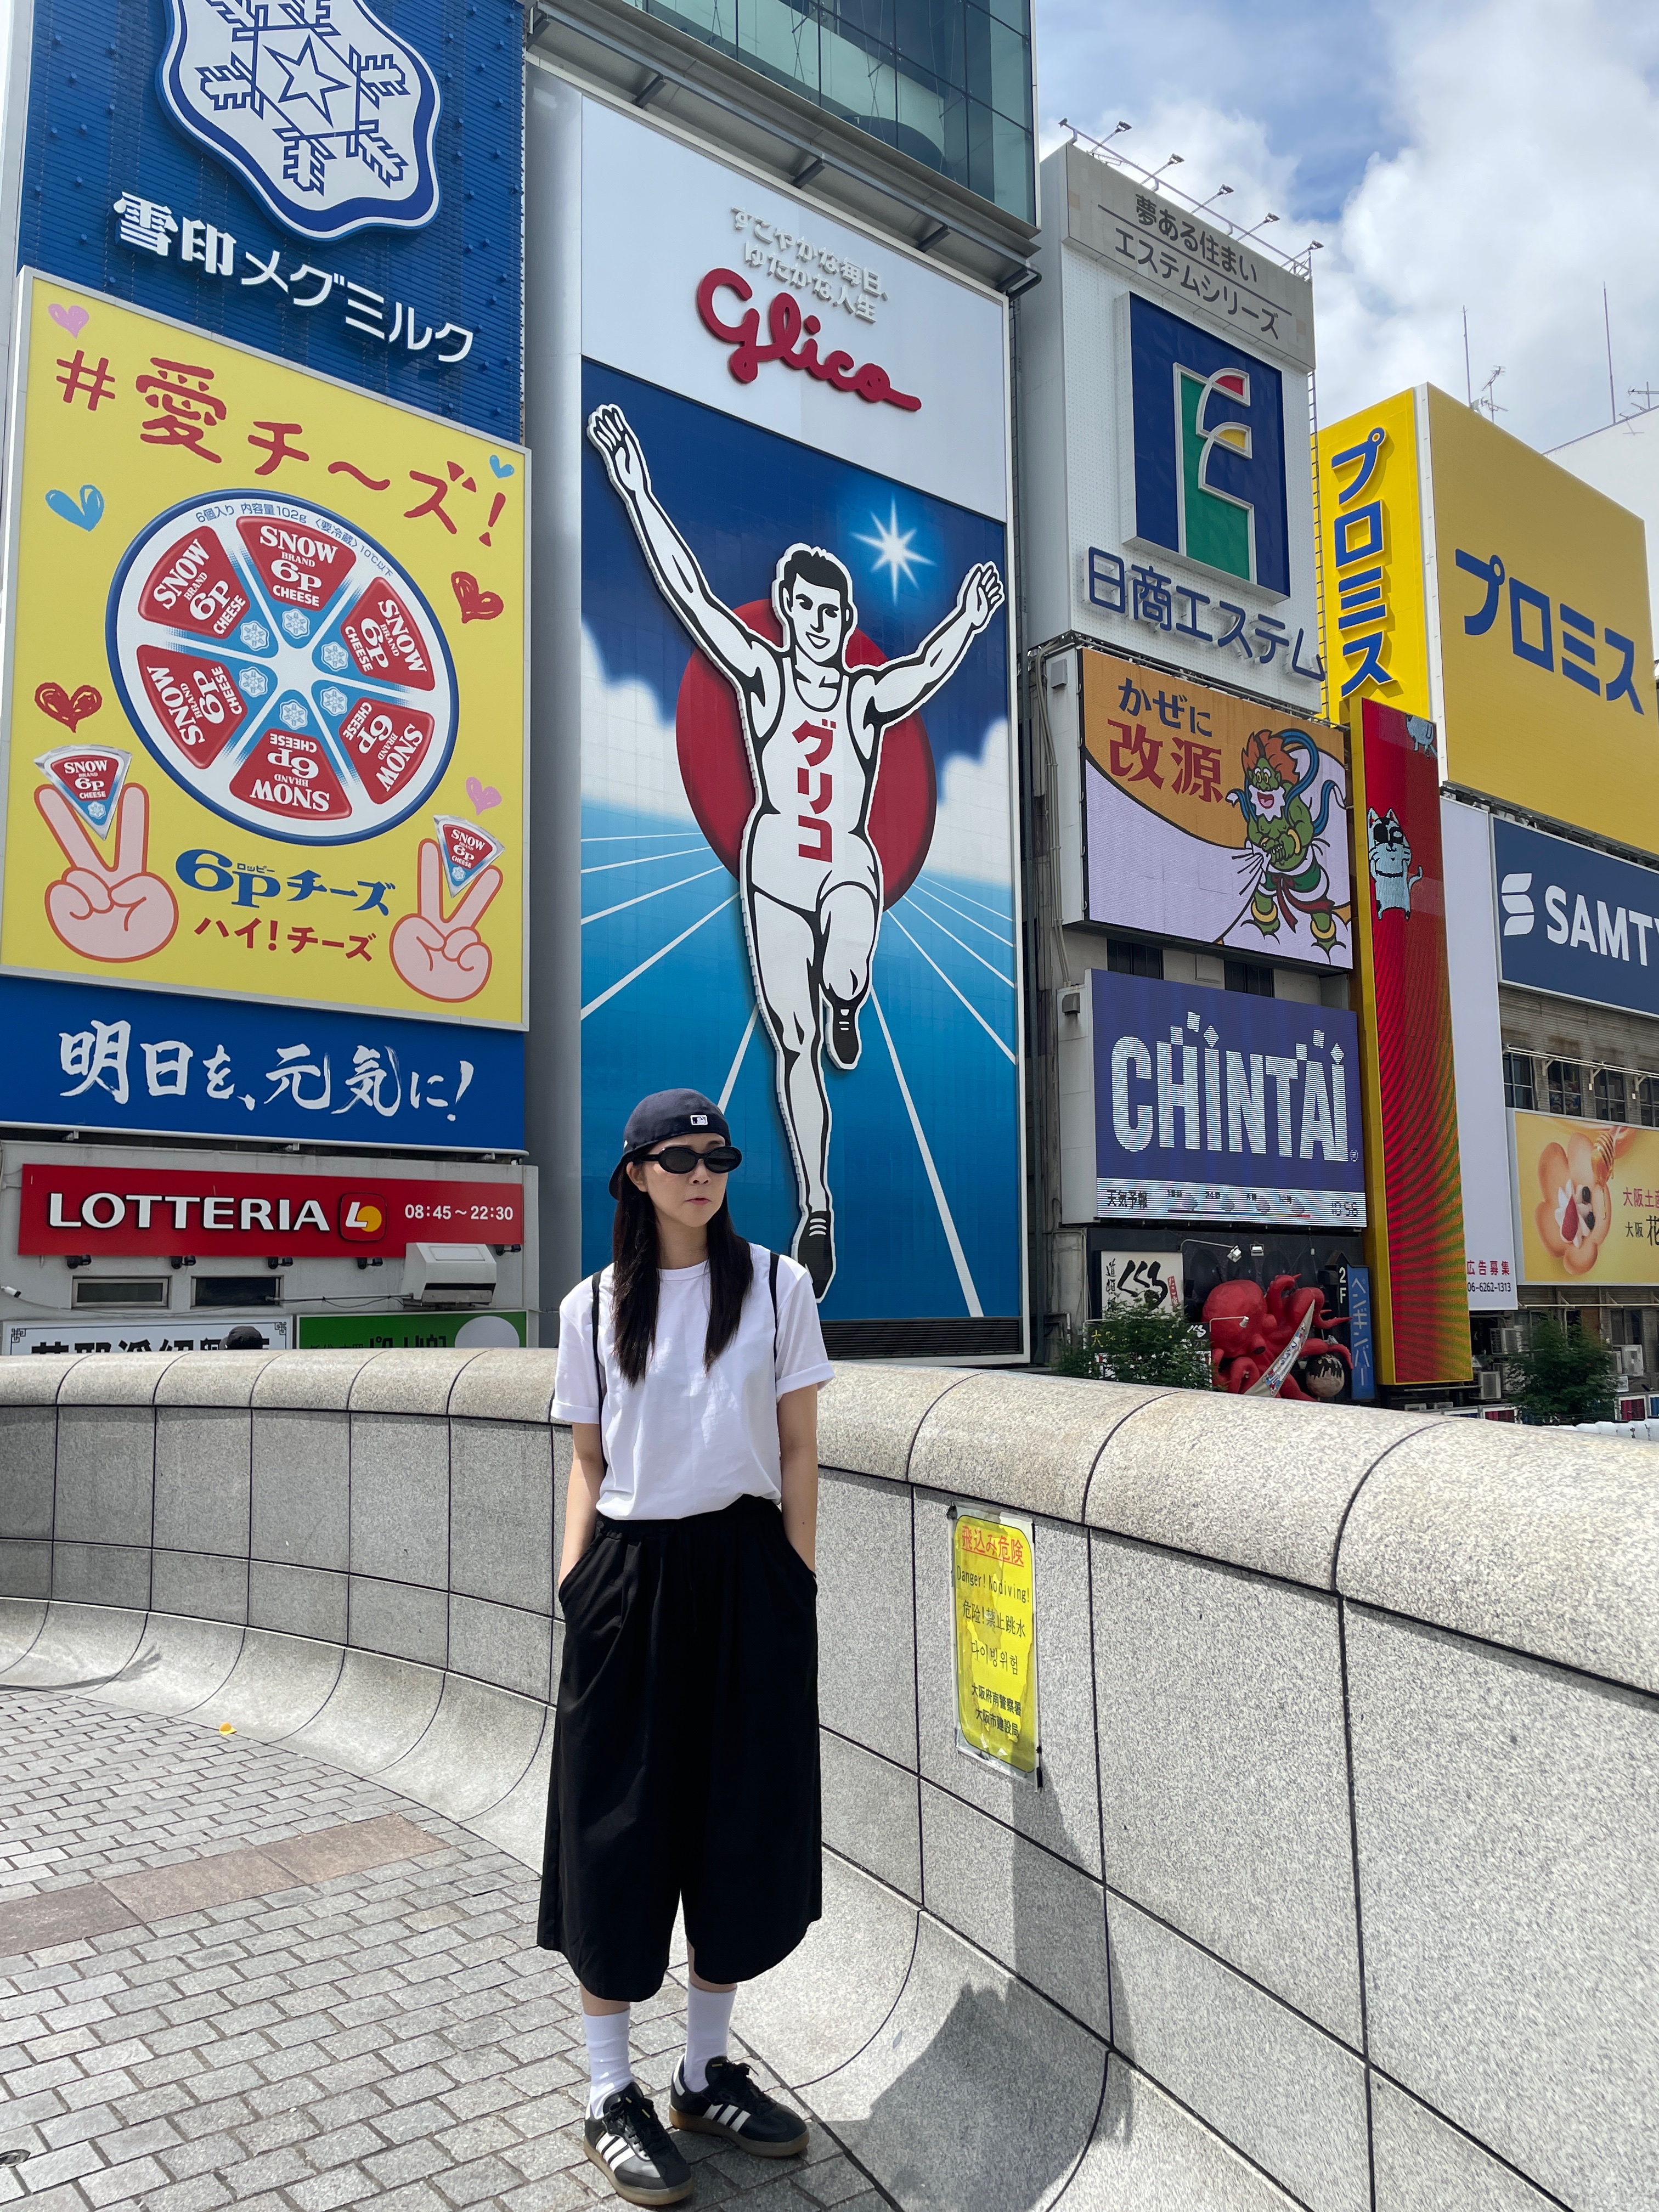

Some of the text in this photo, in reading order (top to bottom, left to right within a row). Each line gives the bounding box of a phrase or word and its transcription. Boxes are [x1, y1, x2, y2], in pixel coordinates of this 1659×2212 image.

[1135, 193, 1257, 283] 夢ある住まい
[114, 191, 473, 363] 雪印メグミルク
[744, 240, 877, 324] ゆたかな人生
[1115, 228, 1279, 340] エステムシリーズ
[697, 268, 922, 412] Glico
[195, 504, 234, 523] 6個入り
[260, 525, 338, 563] SNOW
[281, 551, 315, 567] BRAND
[1331, 427, 1395, 697] プロミス
[153, 538, 210, 610] SNOW
[183, 572, 207, 601] BRAND
[270, 559, 322, 592] 6P
[189, 580, 230, 620] 6P
[213, 595, 246, 634] CHEESE
[273, 584, 320, 607] CHEESE
[1088, 546, 1325, 682] 日商エステム
[345, 626, 374, 672] CHEESE
[361, 618, 389, 668] 6P
[377, 599, 427, 672] SNOW
[379, 623, 399, 657] BRAND
[1455, 548, 1645, 715] プロミス
[146, 666, 205, 745] SNOW
[180, 682, 203, 719] BRAND
[193, 670, 225, 724] 6P
[211, 666, 242, 715] CHEESE
[1118, 676, 1213, 738] かぜに
[342, 702, 372, 741] CHEESE
[357, 714, 393, 754] 6P
[269, 733, 317, 753] CHEESE
[375, 723, 423, 792] SNOW
[377, 732, 398, 760] BRAND
[1107, 718, 1224, 804] 改源
[64, 760, 108, 774] SNOW
[267, 747, 319, 779] 6P
[274, 774, 309, 787] BRAND
[75, 777, 104, 791] 6P
[80, 791, 106, 799] CHEESE
[250, 779, 330, 812] SNOW
[792, 718, 836, 863] グリコ
[451, 829, 486, 850] SNOW
[453, 844, 475, 861] 6P
[237, 863, 275, 874] ロッピー
[452, 855, 472, 868] CHEESE
[194, 917, 377, 962] ハイ!チーズ
[1545, 884, 1659, 966] SAMT
[59, 1020, 474, 1121] 明日を、元気に!
[48, 1192, 330, 1231] LOTTERIA
[1466, 1260, 1510, 1276] 広告募集
[1467, 1282, 1511, 1292] 06-6262-1313
[962, 1525, 1024, 1565] 飛込み危険
[957, 1565, 986, 1589] Danger!
[975, 1707, 1019, 1739] 大阪市建設局
